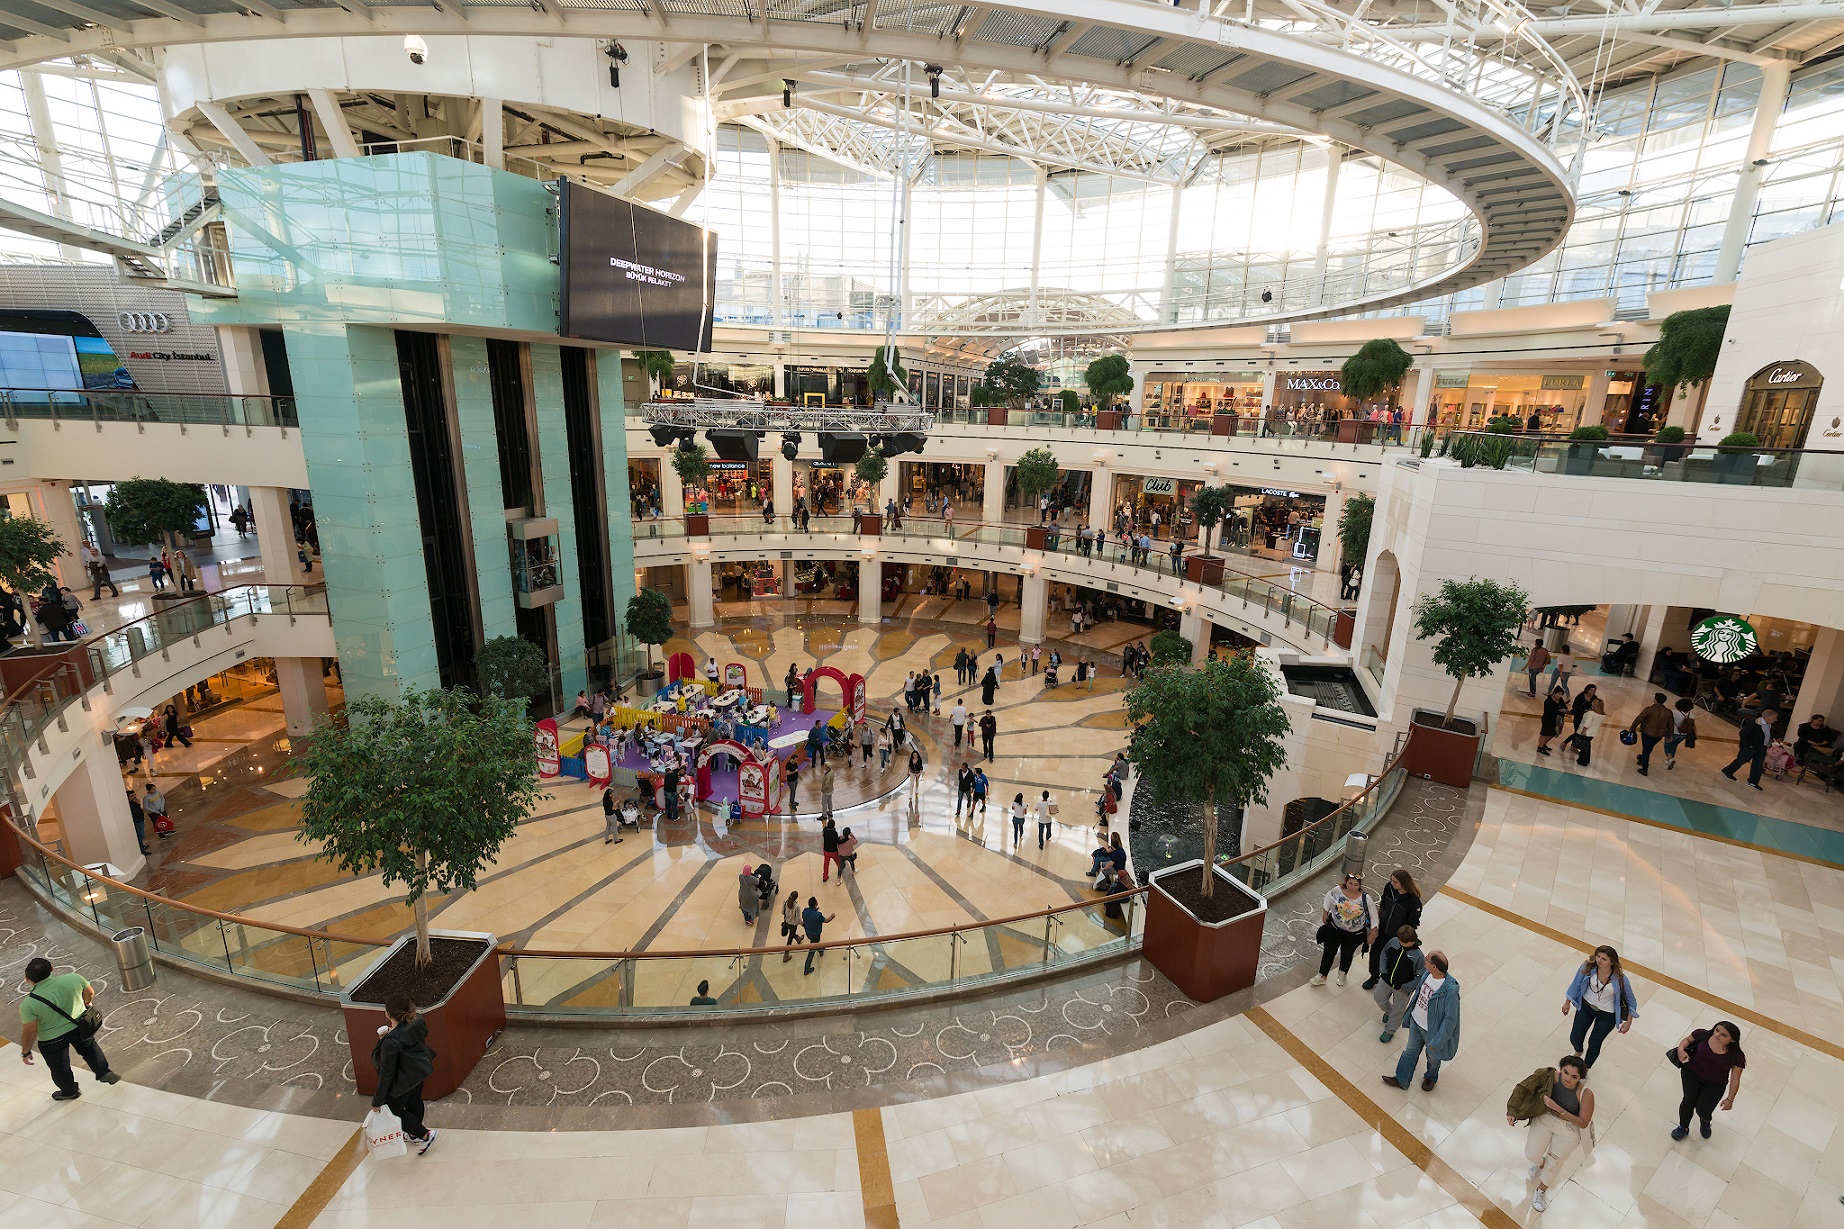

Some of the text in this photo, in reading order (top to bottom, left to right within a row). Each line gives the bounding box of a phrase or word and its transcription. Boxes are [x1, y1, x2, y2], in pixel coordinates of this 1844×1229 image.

[610, 258, 686, 283] DEEPWATER HORIZON
[648, 279, 672, 288] FELAKET
[153, 352, 171, 361] City
[1768, 368, 1803, 384] Cartier
[1544, 379, 1582, 387] FURLA
[1822, 428, 1843, 438] Cartier
[1145, 478, 1172, 492] Club
[1261, 487, 1288, 497] LACOSTE
